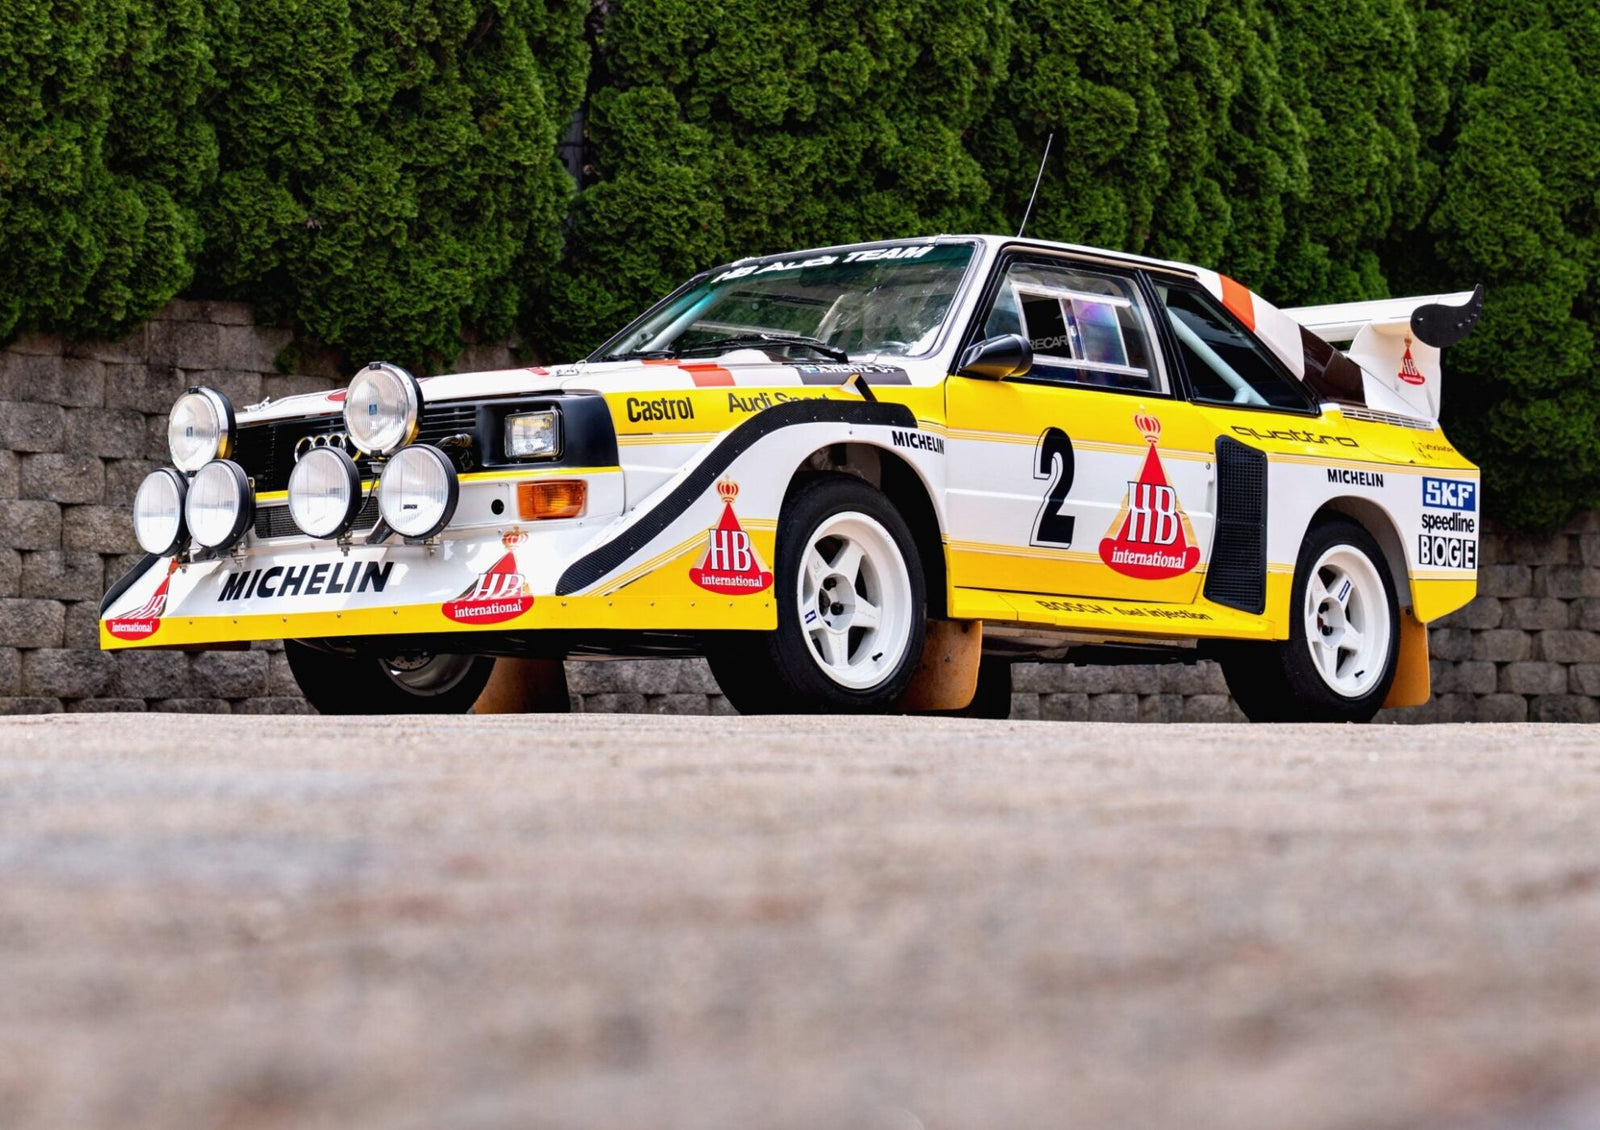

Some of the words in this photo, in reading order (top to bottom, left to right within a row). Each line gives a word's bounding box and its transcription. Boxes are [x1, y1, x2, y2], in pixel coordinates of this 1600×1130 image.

[711, 264, 759, 285] HB
[842, 246, 935, 263] TEAM
[1029, 335, 1069, 350] RECAR
[626, 397, 695, 423] Castrol
[728, 392, 773, 413] Audi
[891, 430, 945, 455] MICHELIN
[1231, 425, 1359, 448] quattro
[1029, 427, 1075, 550] 2
[1327, 468, 1384, 488] MICHELIN
[1425, 480, 1473, 508] SKF
[1125, 481, 1179, 546] HB
[1421, 512, 1475, 534] speedline
[708, 528, 751, 572] HB
[1111, 546, 1187, 570] international
[1418, 534, 1476, 569] BOGE
[217, 561, 395, 602] MICHELIN
[464, 573, 527, 602] HB
[701, 573, 763, 588] international
[454, 598, 522, 618] international
[1035, 600, 1112, 615] BOSCH
[1113, 606, 1151, 618] fuel
[1143, 607, 1214, 622] injection
